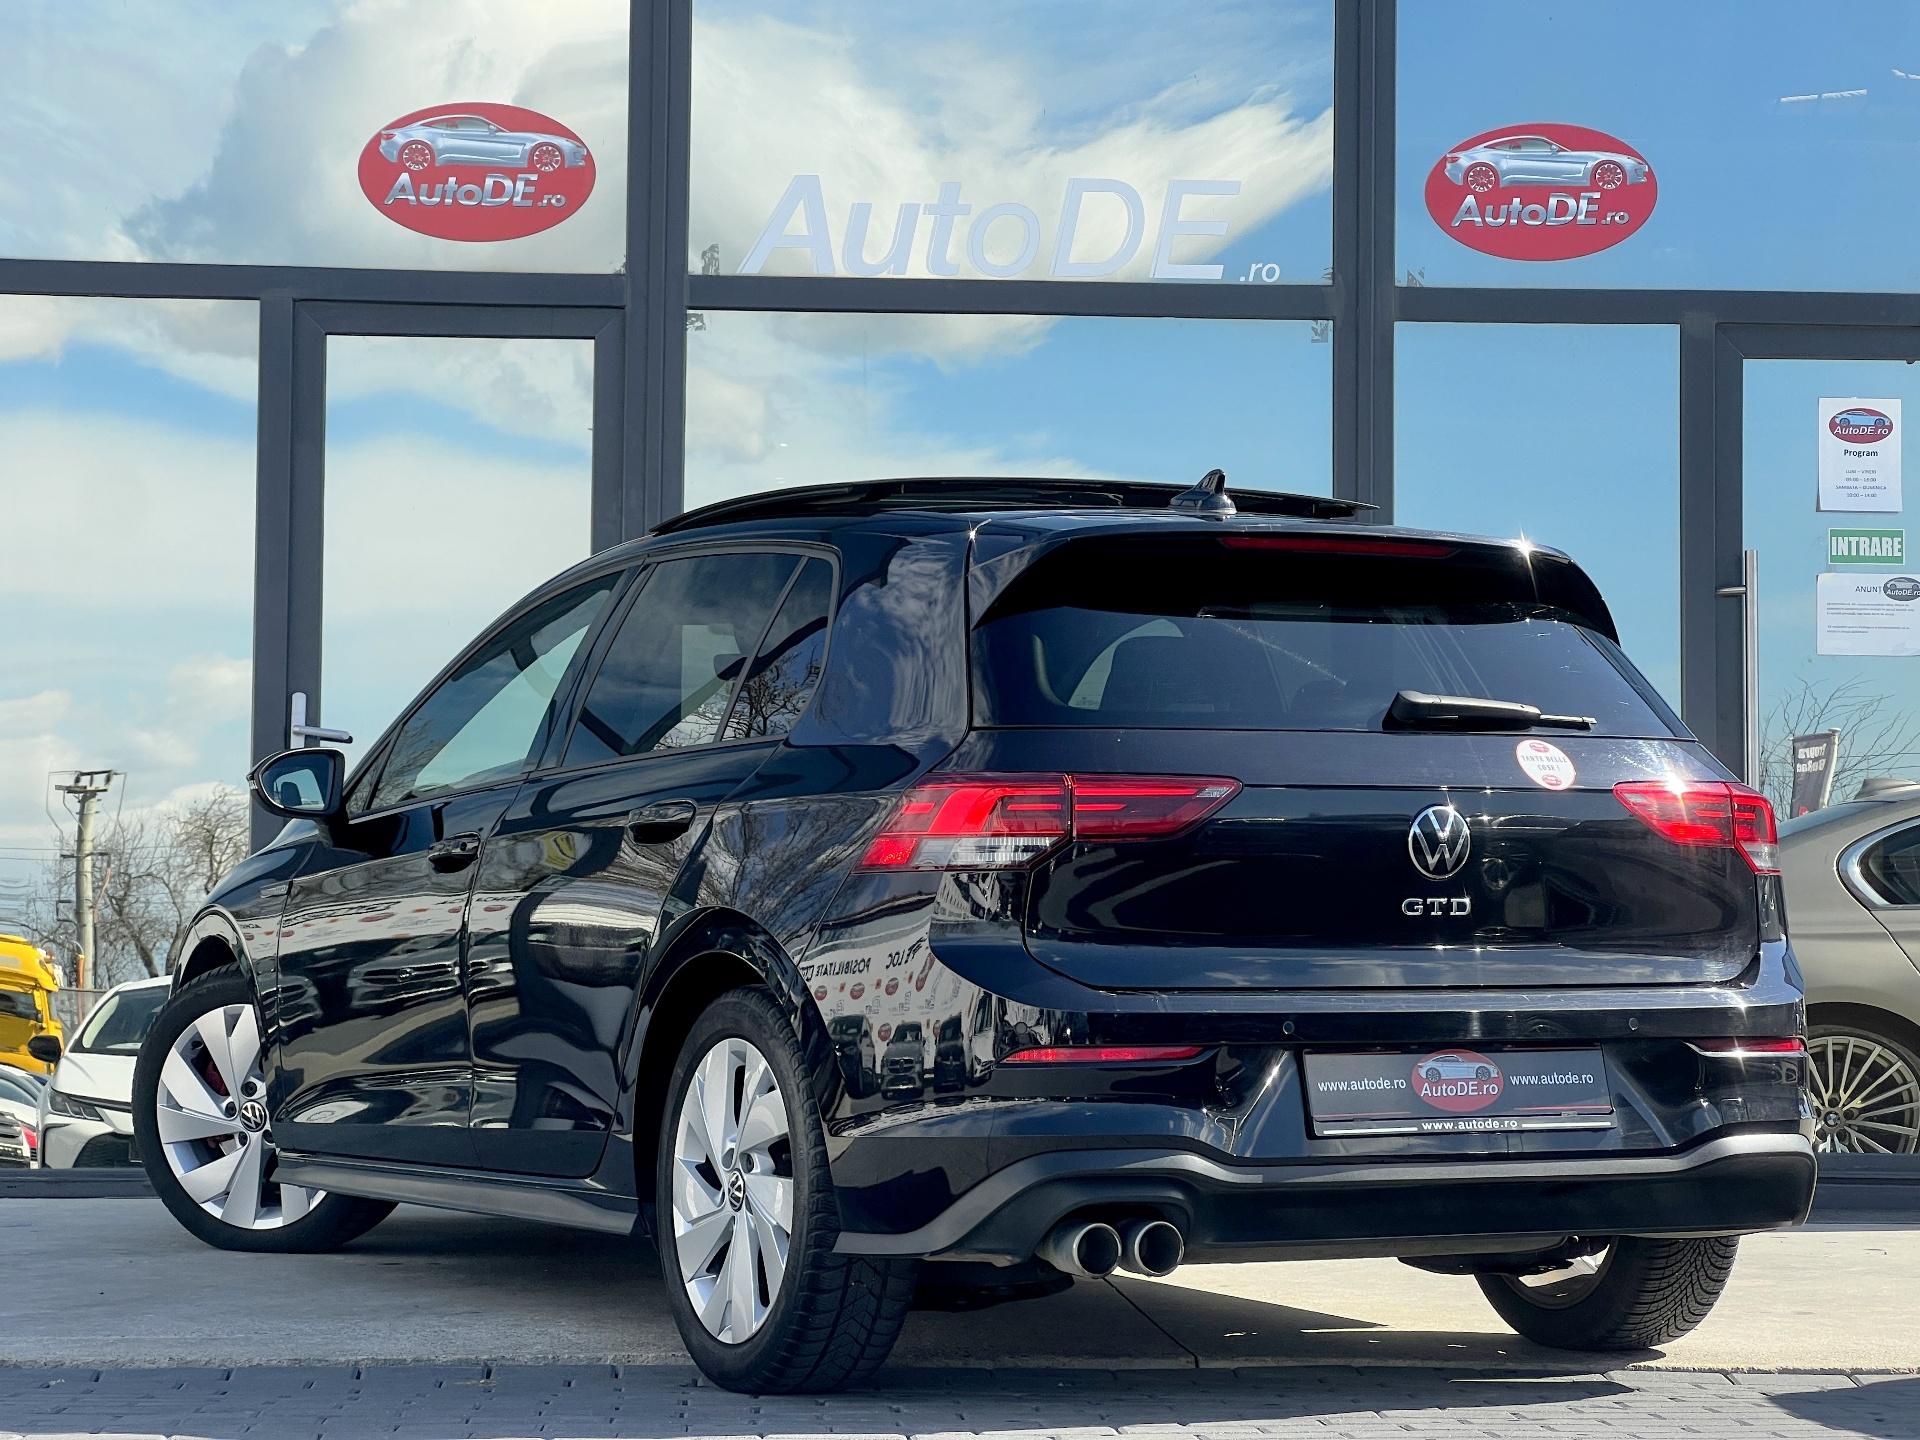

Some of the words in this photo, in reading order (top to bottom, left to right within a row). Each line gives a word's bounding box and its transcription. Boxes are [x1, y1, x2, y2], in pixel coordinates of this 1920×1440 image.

[1843, 449, 1878, 458] Program
[1832, 536, 1902, 557] INTRARE
[1401, 897, 1472, 916] GTD
[1318, 1078, 1406, 1093] www.autode.ro
[1510, 1071, 1594, 1086] www.autode.ro
[1420, 1081, 1499, 1098] AutoDE.ro
[1421, 1119, 1518, 1131] www.autode.ro
